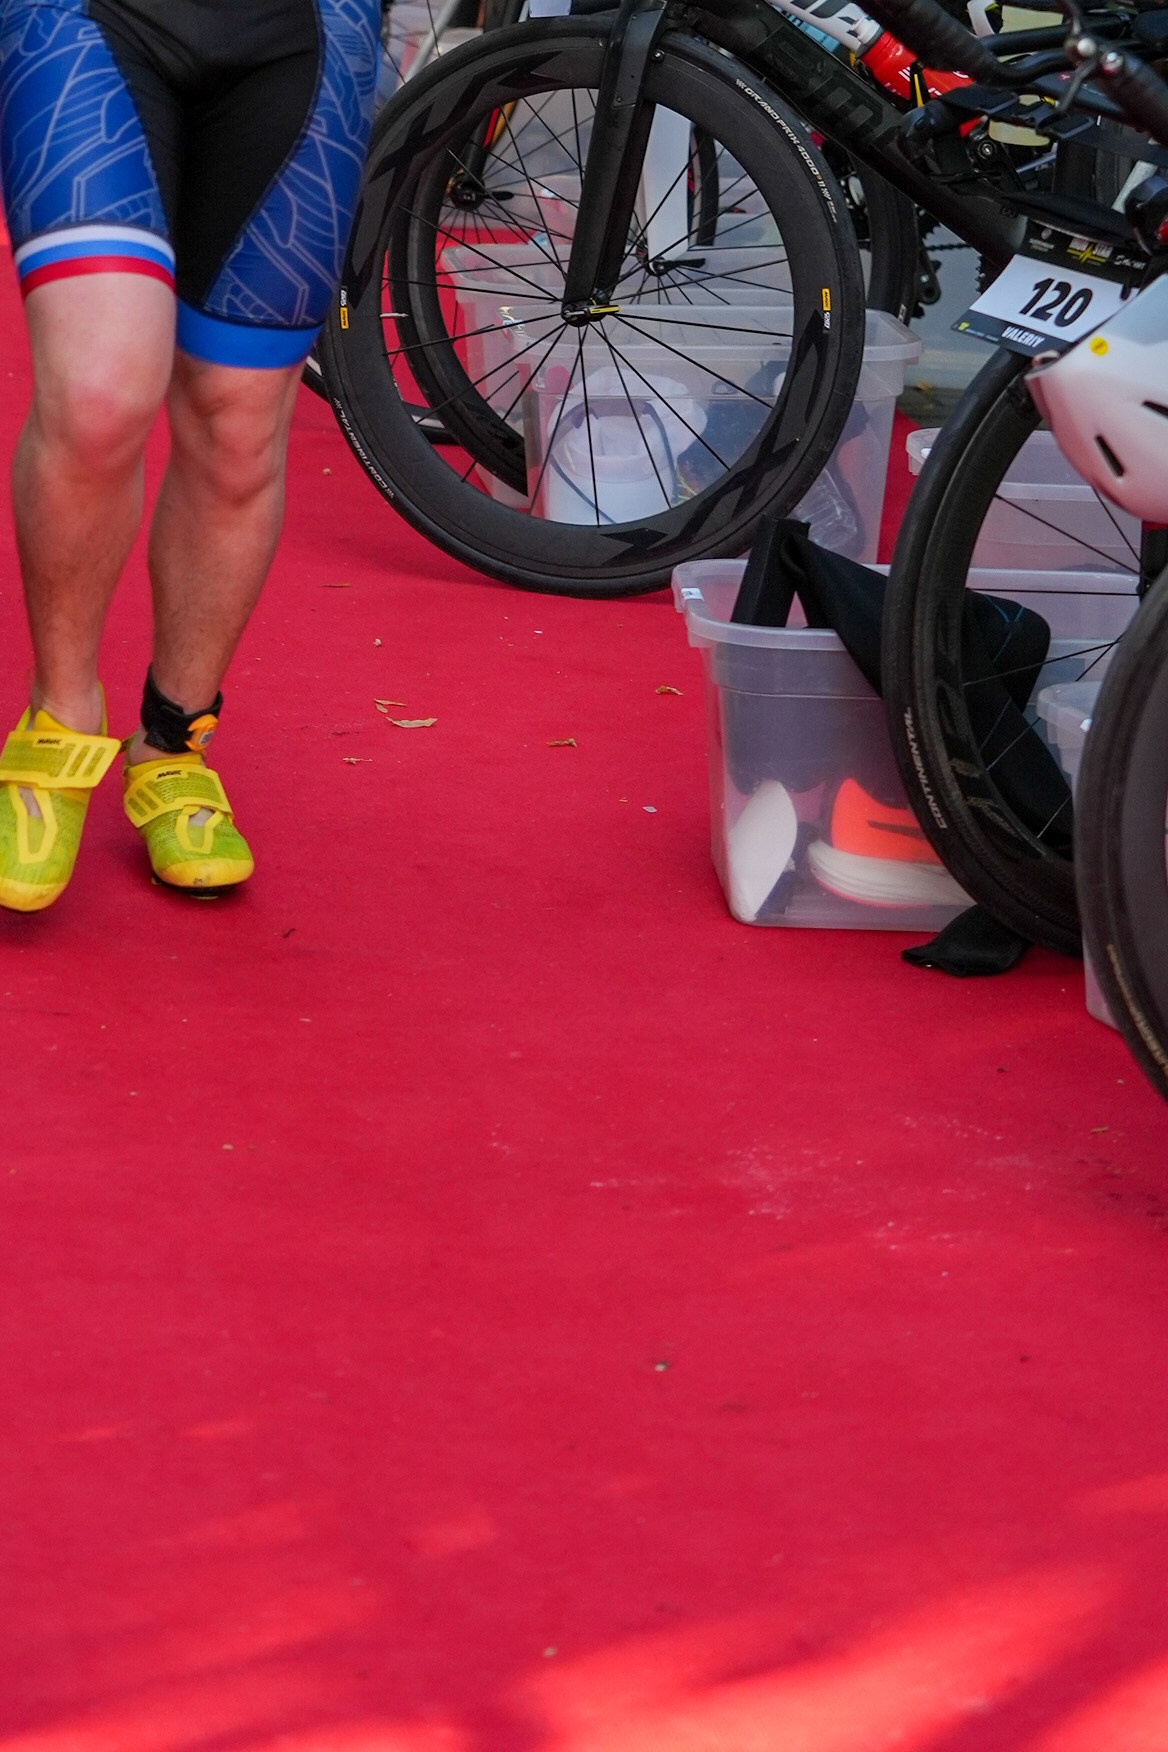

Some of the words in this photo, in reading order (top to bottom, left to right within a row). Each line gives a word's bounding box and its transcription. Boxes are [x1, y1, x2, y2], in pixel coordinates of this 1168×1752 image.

[744, 87, 779, 121] GRAND
[776, 119, 800, 145] PRIX
[1019, 278, 1093, 327] 120
[1001, 325, 1045, 348] VALERIY
[339, 409, 388, 491] CONTINENTAL
[36, 737, 63, 746] MAVIC
[156, 769, 183, 780] MAVIC
[903, 707, 948, 829] CONTINENTAL
